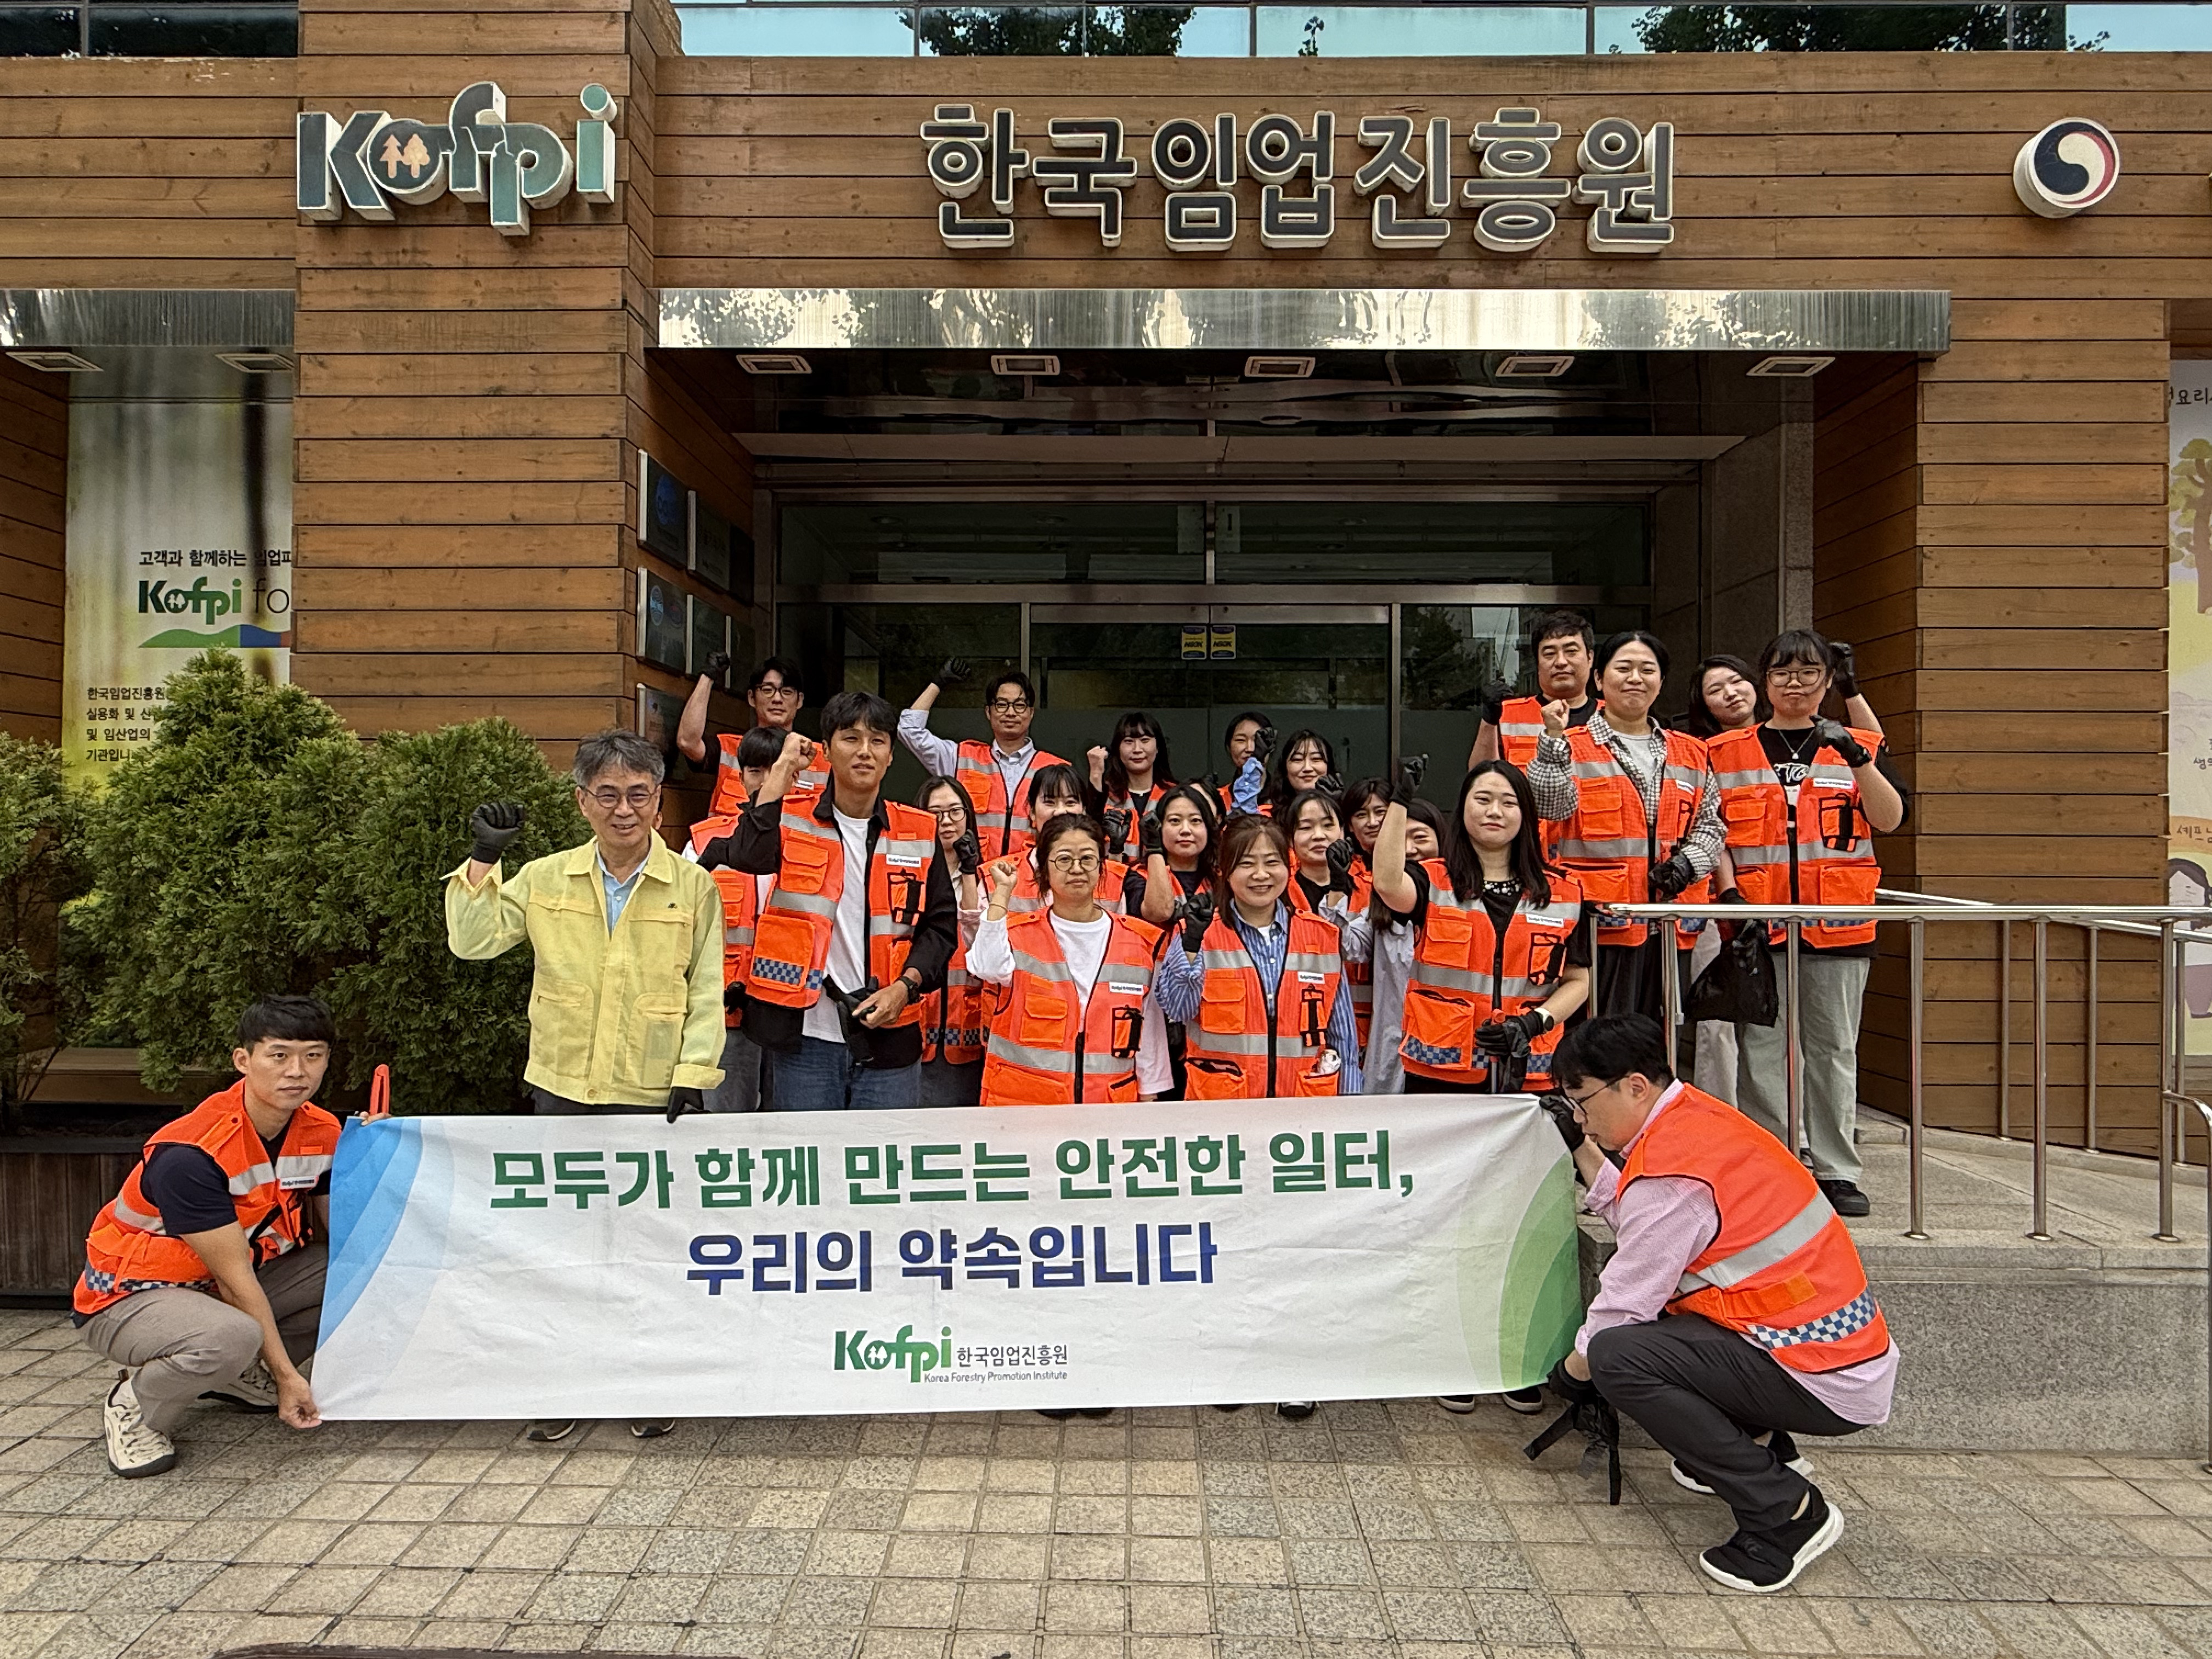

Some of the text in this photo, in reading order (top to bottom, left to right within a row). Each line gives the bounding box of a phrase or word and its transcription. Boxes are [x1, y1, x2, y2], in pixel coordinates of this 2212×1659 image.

[297, 81, 617, 236] Kofpi
[920, 103, 1674, 252] 한국임업진흥원
[2169, 386, 2212, 407] 요리
[139, 550, 183, 567] 고객과
[189, 550, 247, 567] 함께하는
[138, 576, 290, 625] Kofpi fo
[87, 687, 168, 700] 한국임업진흥원
[87, 708, 119, 720] 실용화
[125, 708, 135, 721] 및
[87, 728, 150, 741] 및 임산업의
[86, 748, 131, 761] 기관입니
[490, 1130, 1414, 1209] 모두가 함께 만드는 안전한 일터,
[687, 1221, 1218, 1296] 우리의 약속입니다
[834, 1324, 951, 1383] Kofpi
[957, 1344, 1068, 1367] 한국임업진흥원
[924, 1370, 1068, 1384] Korea Forestry Promotion Institute
